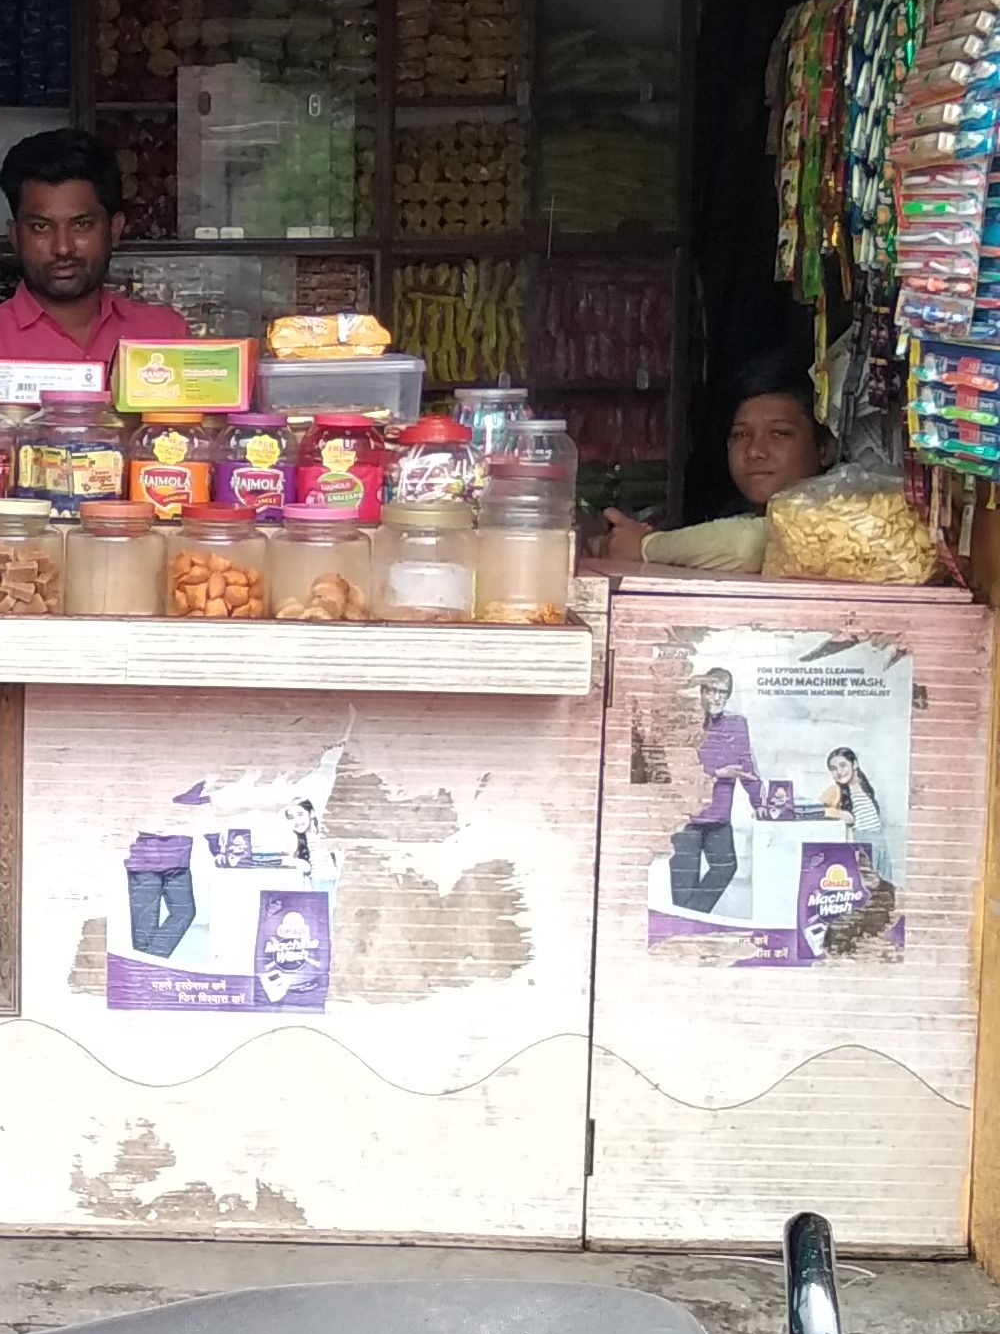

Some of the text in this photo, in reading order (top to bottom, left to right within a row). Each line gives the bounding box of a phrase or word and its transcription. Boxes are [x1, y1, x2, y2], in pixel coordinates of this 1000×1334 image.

[139, 474, 192, 489] HAJMOLA
[230, 476, 286, 492] HAJMOLA
[757, 667, 865, 675] FOR EFFORTLESS CLEANING
[756, 677, 793, 687] GHADI
[795, 677, 848, 687] MACHINE
[757, 689, 891, 697] THE WASHING MACHINE SPECIALIST
[807, 890, 863, 907] Machine
[819, 902, 853, 916] Wash
